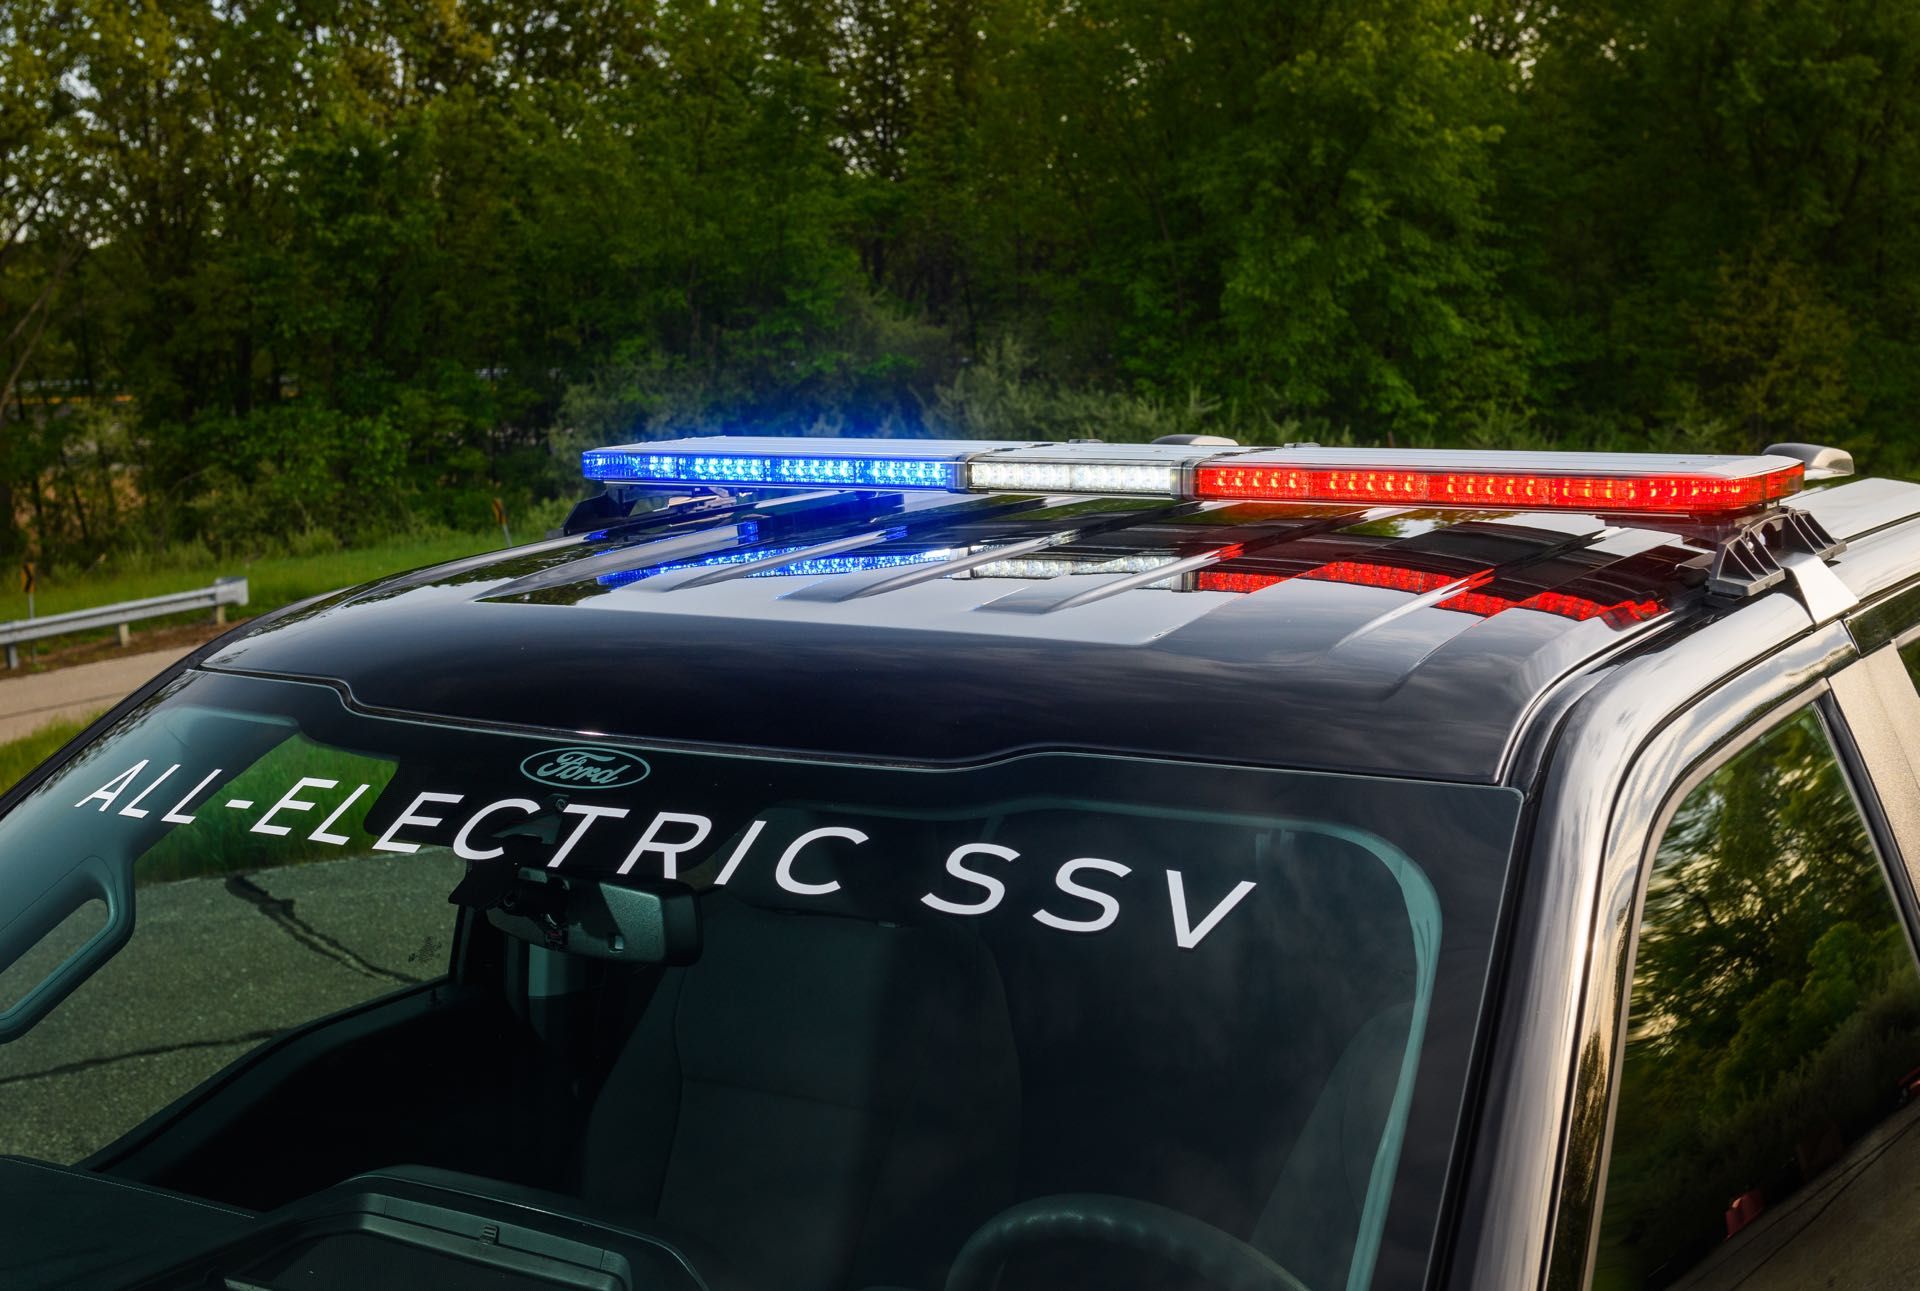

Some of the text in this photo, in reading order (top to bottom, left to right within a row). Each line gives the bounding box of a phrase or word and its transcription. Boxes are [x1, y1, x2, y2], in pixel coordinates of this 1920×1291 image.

[536, 751, 631, 784] Ford
[74, 759, 1257, 949] ALL-ELECTRIC SSV
